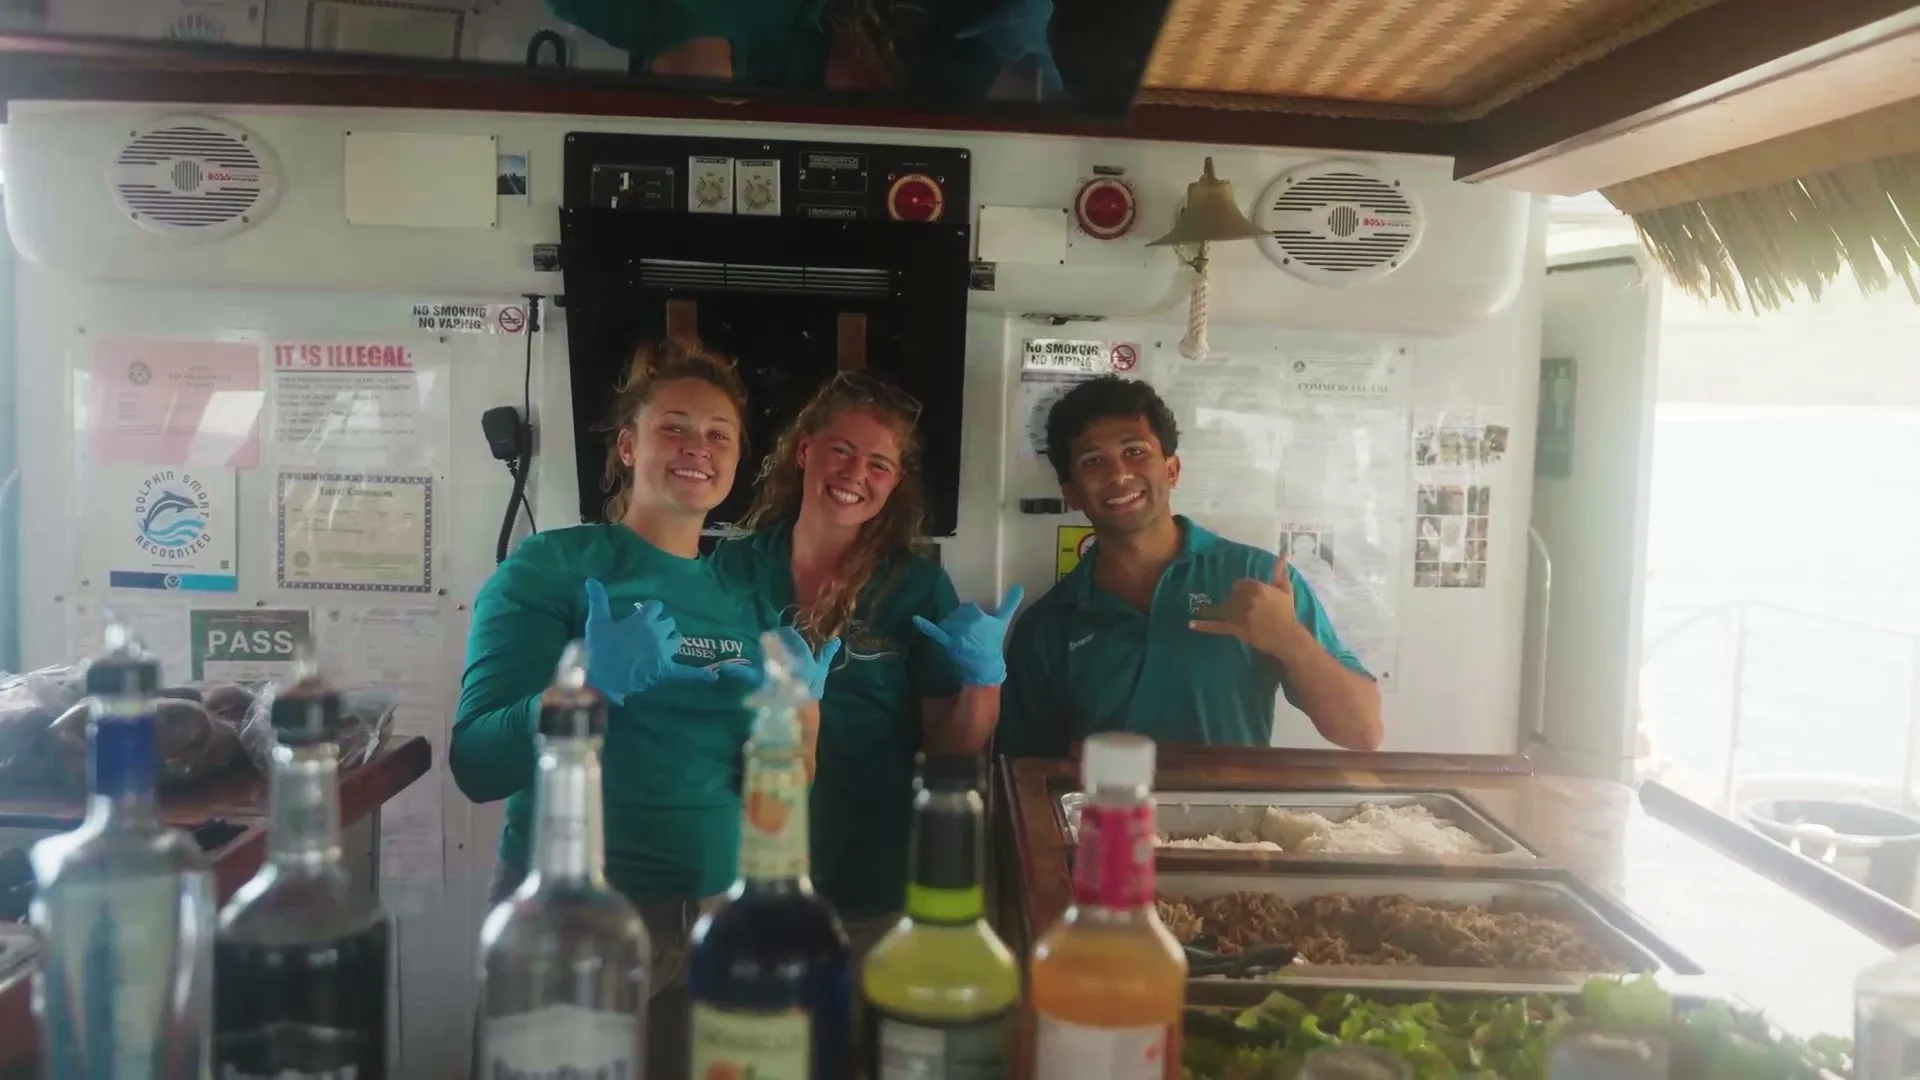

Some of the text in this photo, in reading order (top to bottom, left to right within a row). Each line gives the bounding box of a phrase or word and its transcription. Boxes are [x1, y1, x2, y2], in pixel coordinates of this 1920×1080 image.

[413, 305, 487, 318] NO SMOKING
[419, 317, 481, 329] NO VAPING
[275, 344, 295, 367] IT
[301, 344, 322, 367] IS
[1026, 342, 1099, 355] NO SMOKING
[1031, 354, 1092, 368] NO VAPING
[135, 470, 210, 518] DOLPHIN SMART
[135, 533, 211, 559] RECOGNIZED
[207, 630, 294, 654] PASS
[676, 646, 716, 659] RUISES
